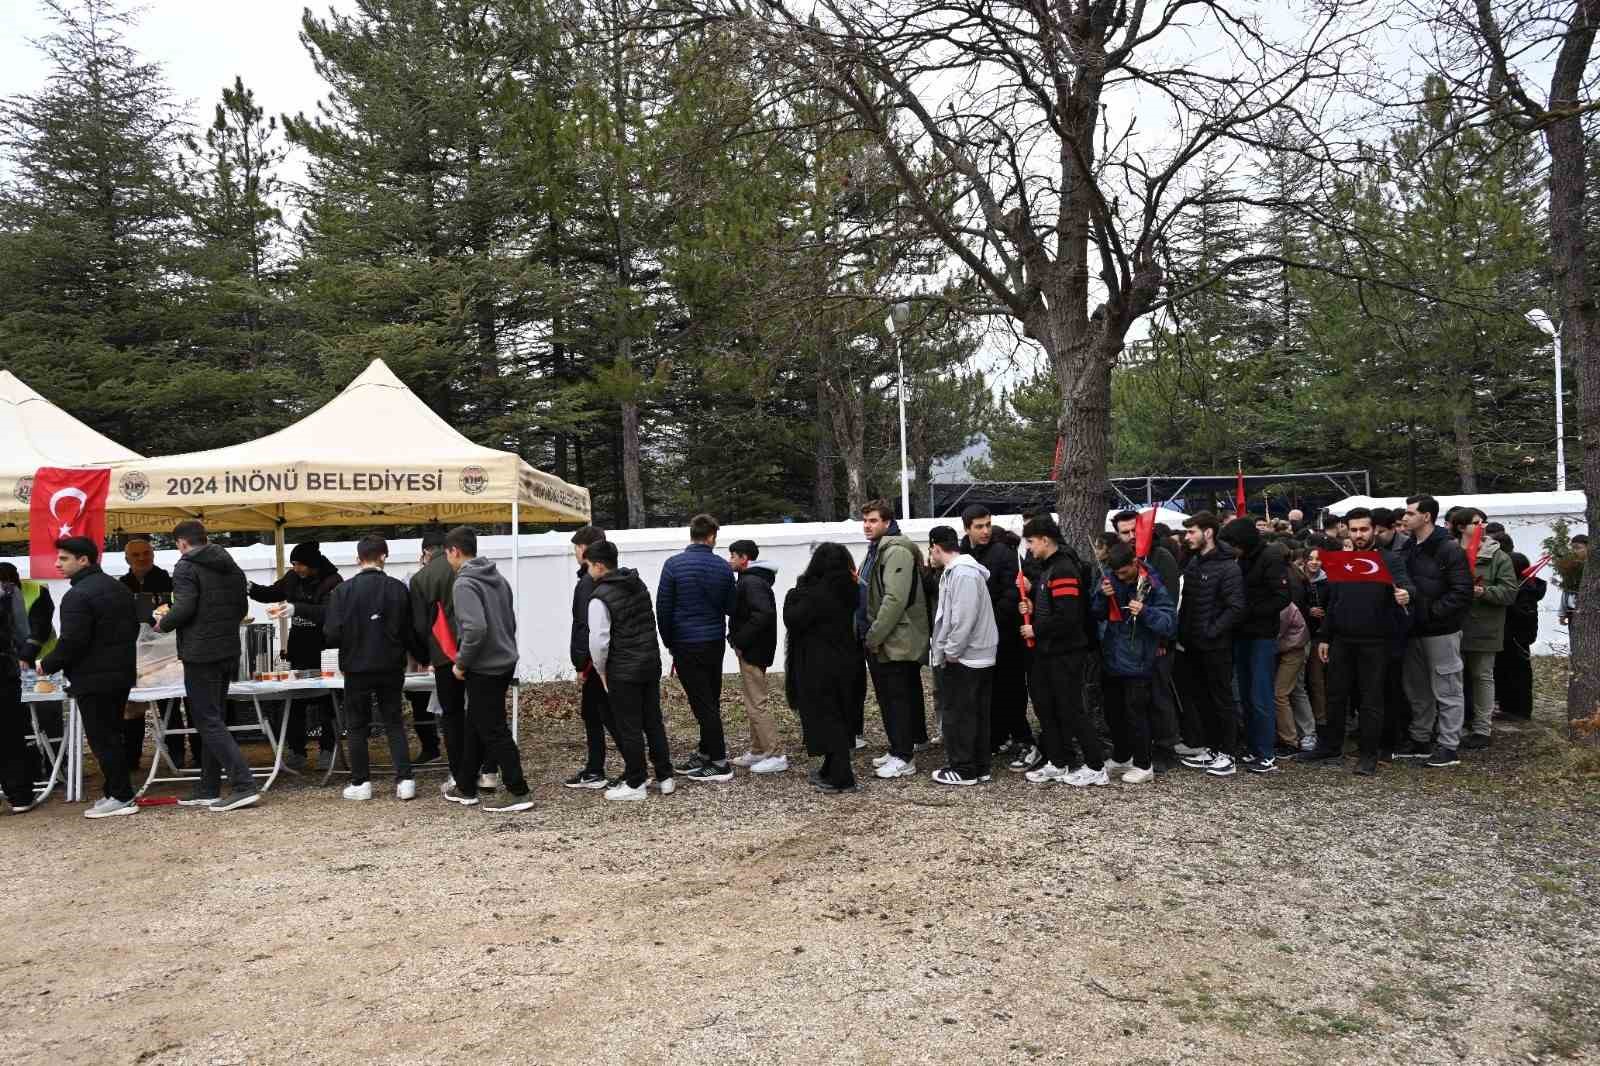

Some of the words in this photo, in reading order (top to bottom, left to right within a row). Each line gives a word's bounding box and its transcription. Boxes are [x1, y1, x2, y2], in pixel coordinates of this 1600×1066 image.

[167, 476, 217, 495] 2024
[225, 469, 298, 493] İNÖNÜ
[307, 468, 443, 491] BELEDİYESİ
